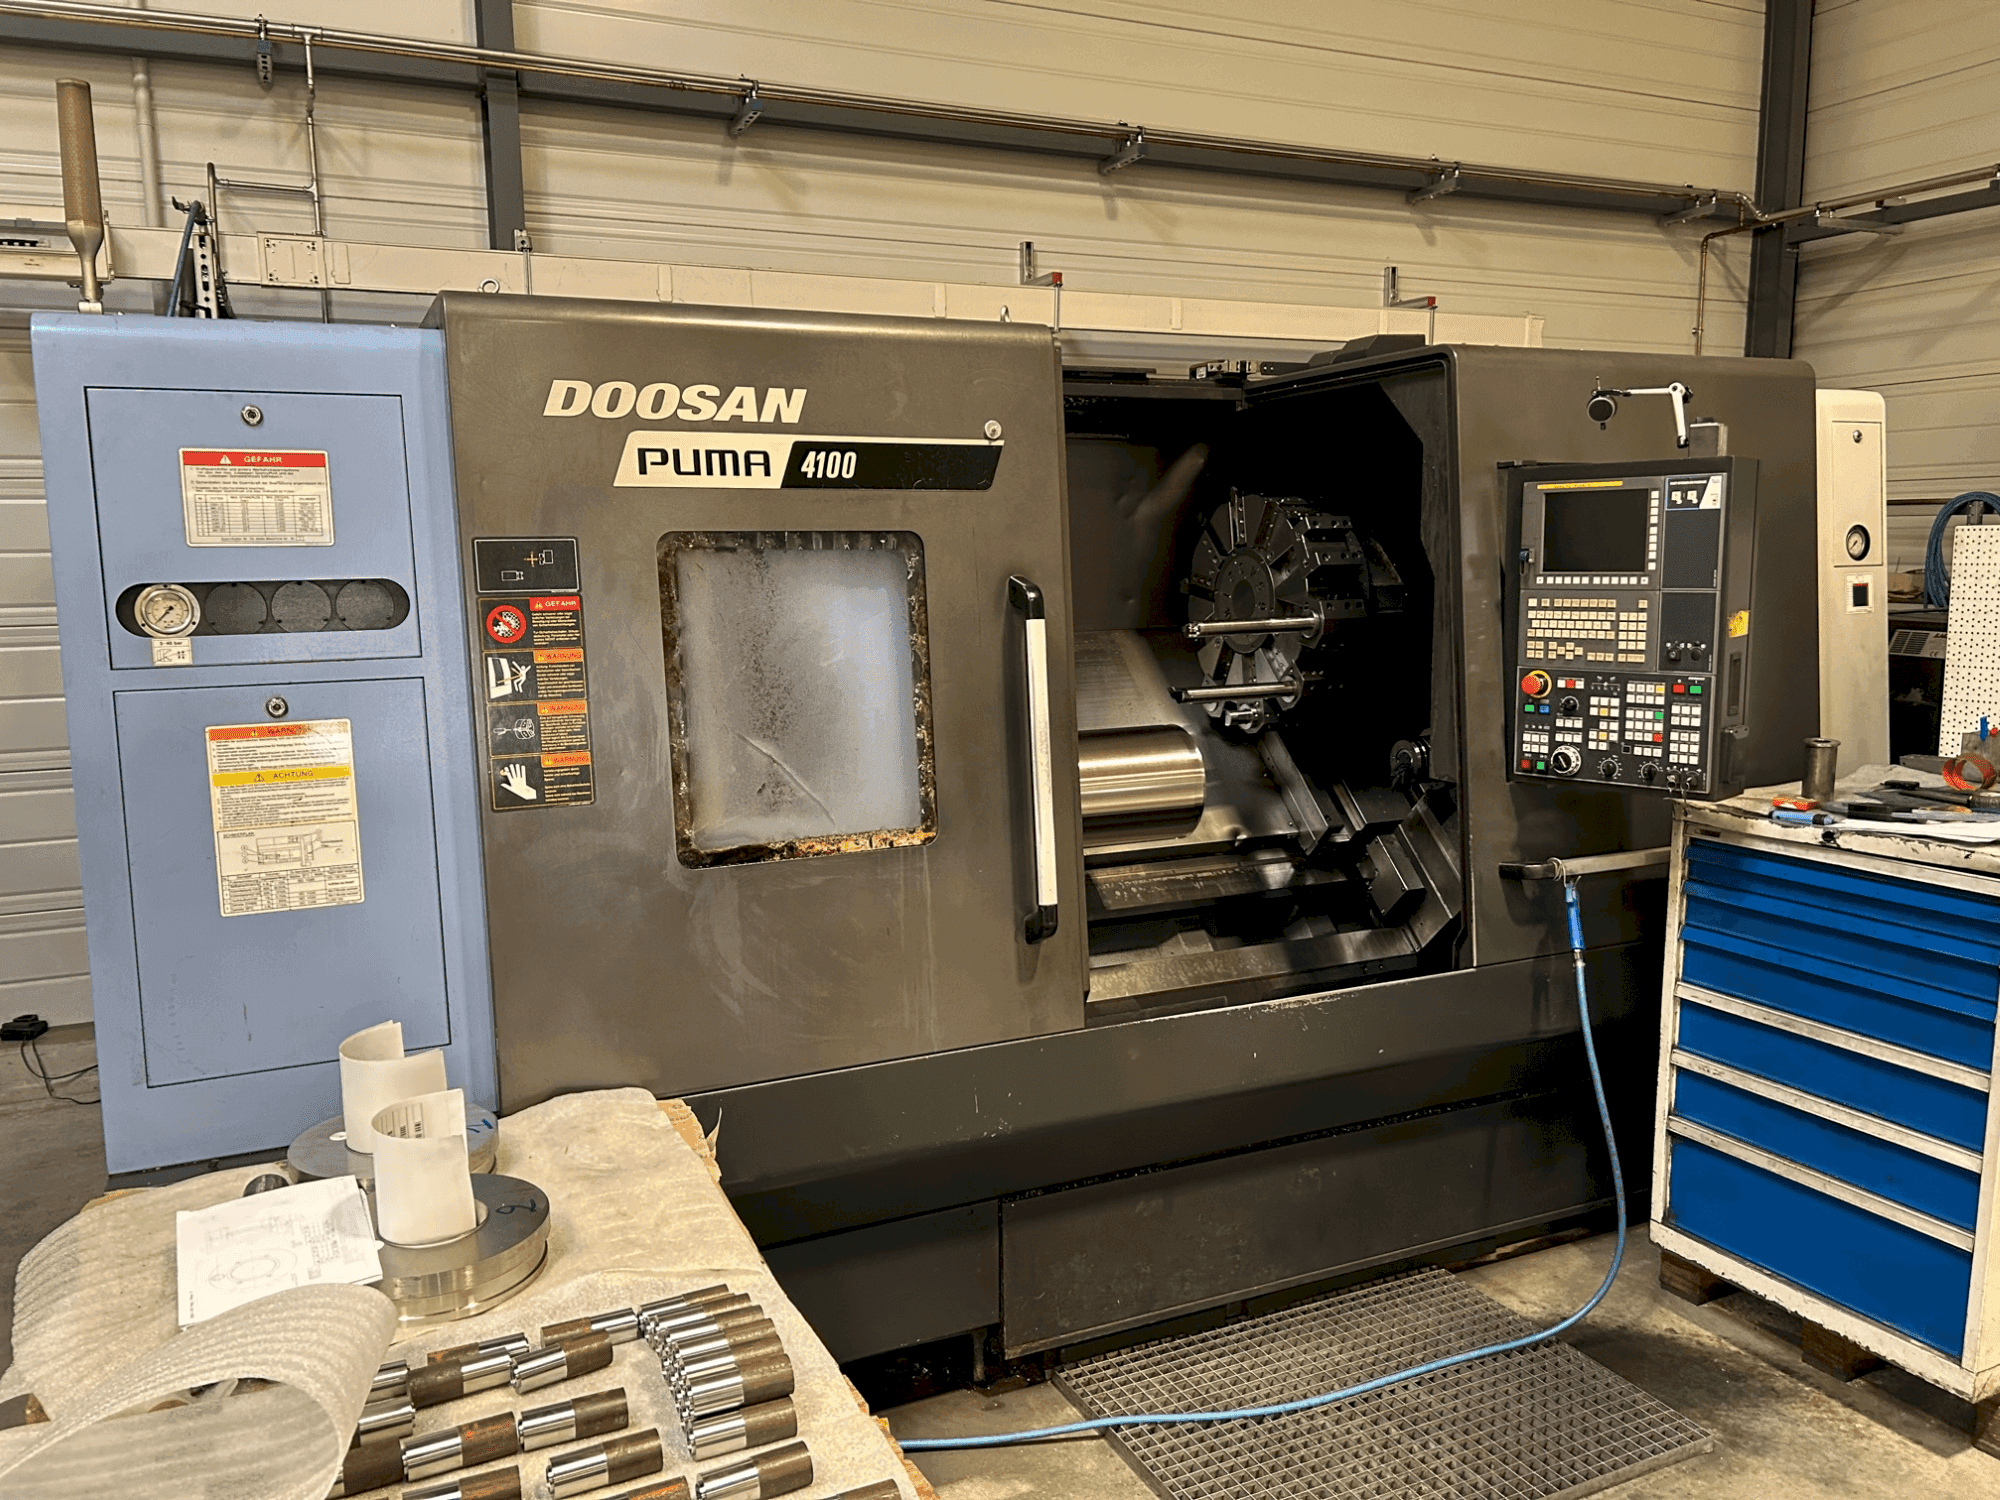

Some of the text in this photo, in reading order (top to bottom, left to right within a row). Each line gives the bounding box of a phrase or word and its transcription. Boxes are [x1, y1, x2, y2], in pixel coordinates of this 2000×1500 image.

[542, 379, 808, 424] DOOSAN
[243, 455, 283, 463] GEFAHR
[636, 447, 857, 480] PUMA 4100
[272, 769, 314, 779] ACHTUNG
